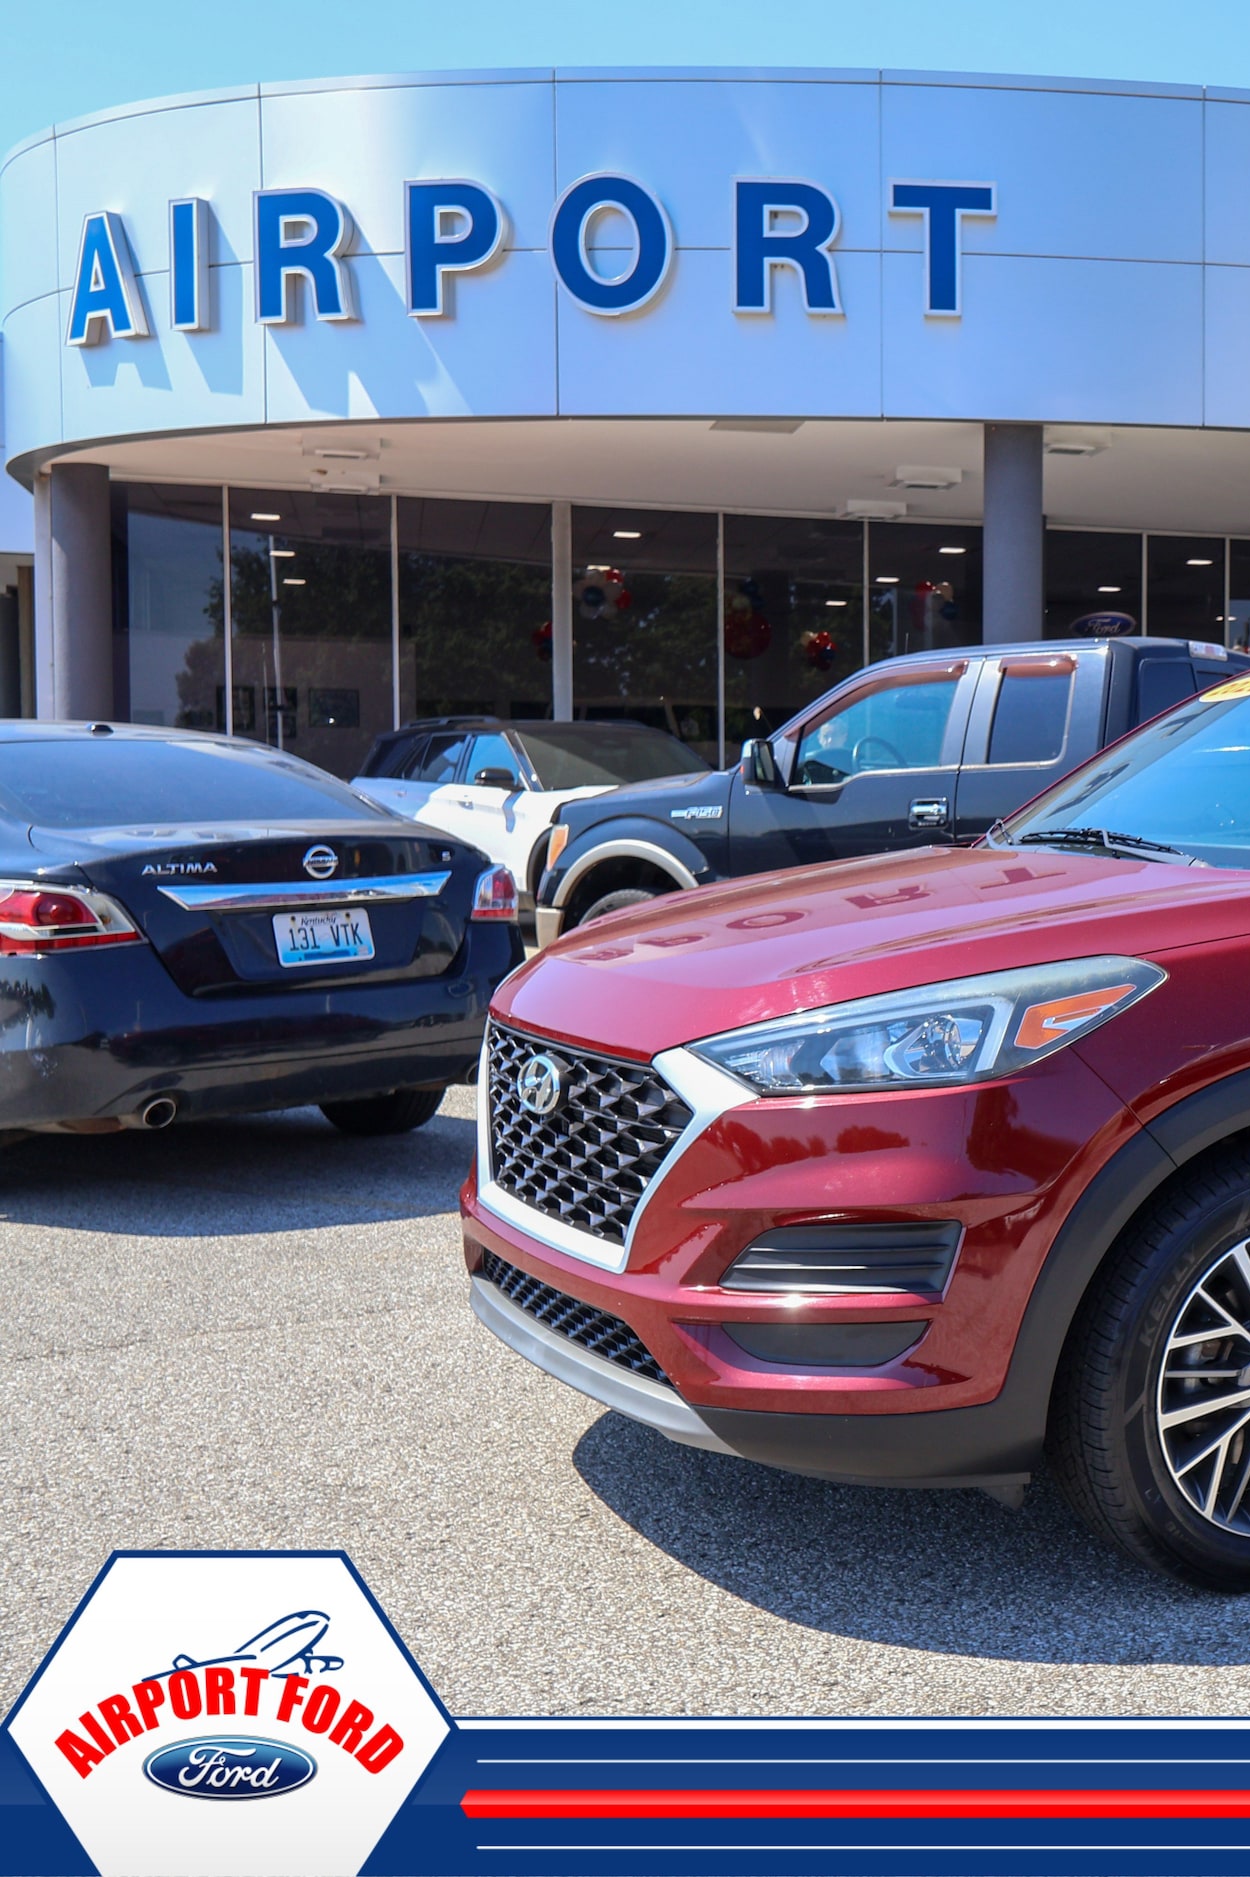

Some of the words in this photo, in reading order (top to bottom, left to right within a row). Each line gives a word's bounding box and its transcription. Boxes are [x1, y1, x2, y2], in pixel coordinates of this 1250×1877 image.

[66, 170, 998, 347] AIRPORT
[1084, 618, 1121, 634] Ford
[141, 861, 218, 876] ALTIMA
[301, 913, 337, 926] Kentucky
[289, 927, 320, 951] 131
[330, 922, 363, 947] VTK
[1138, 1242, 1196, 1347] KELLY
